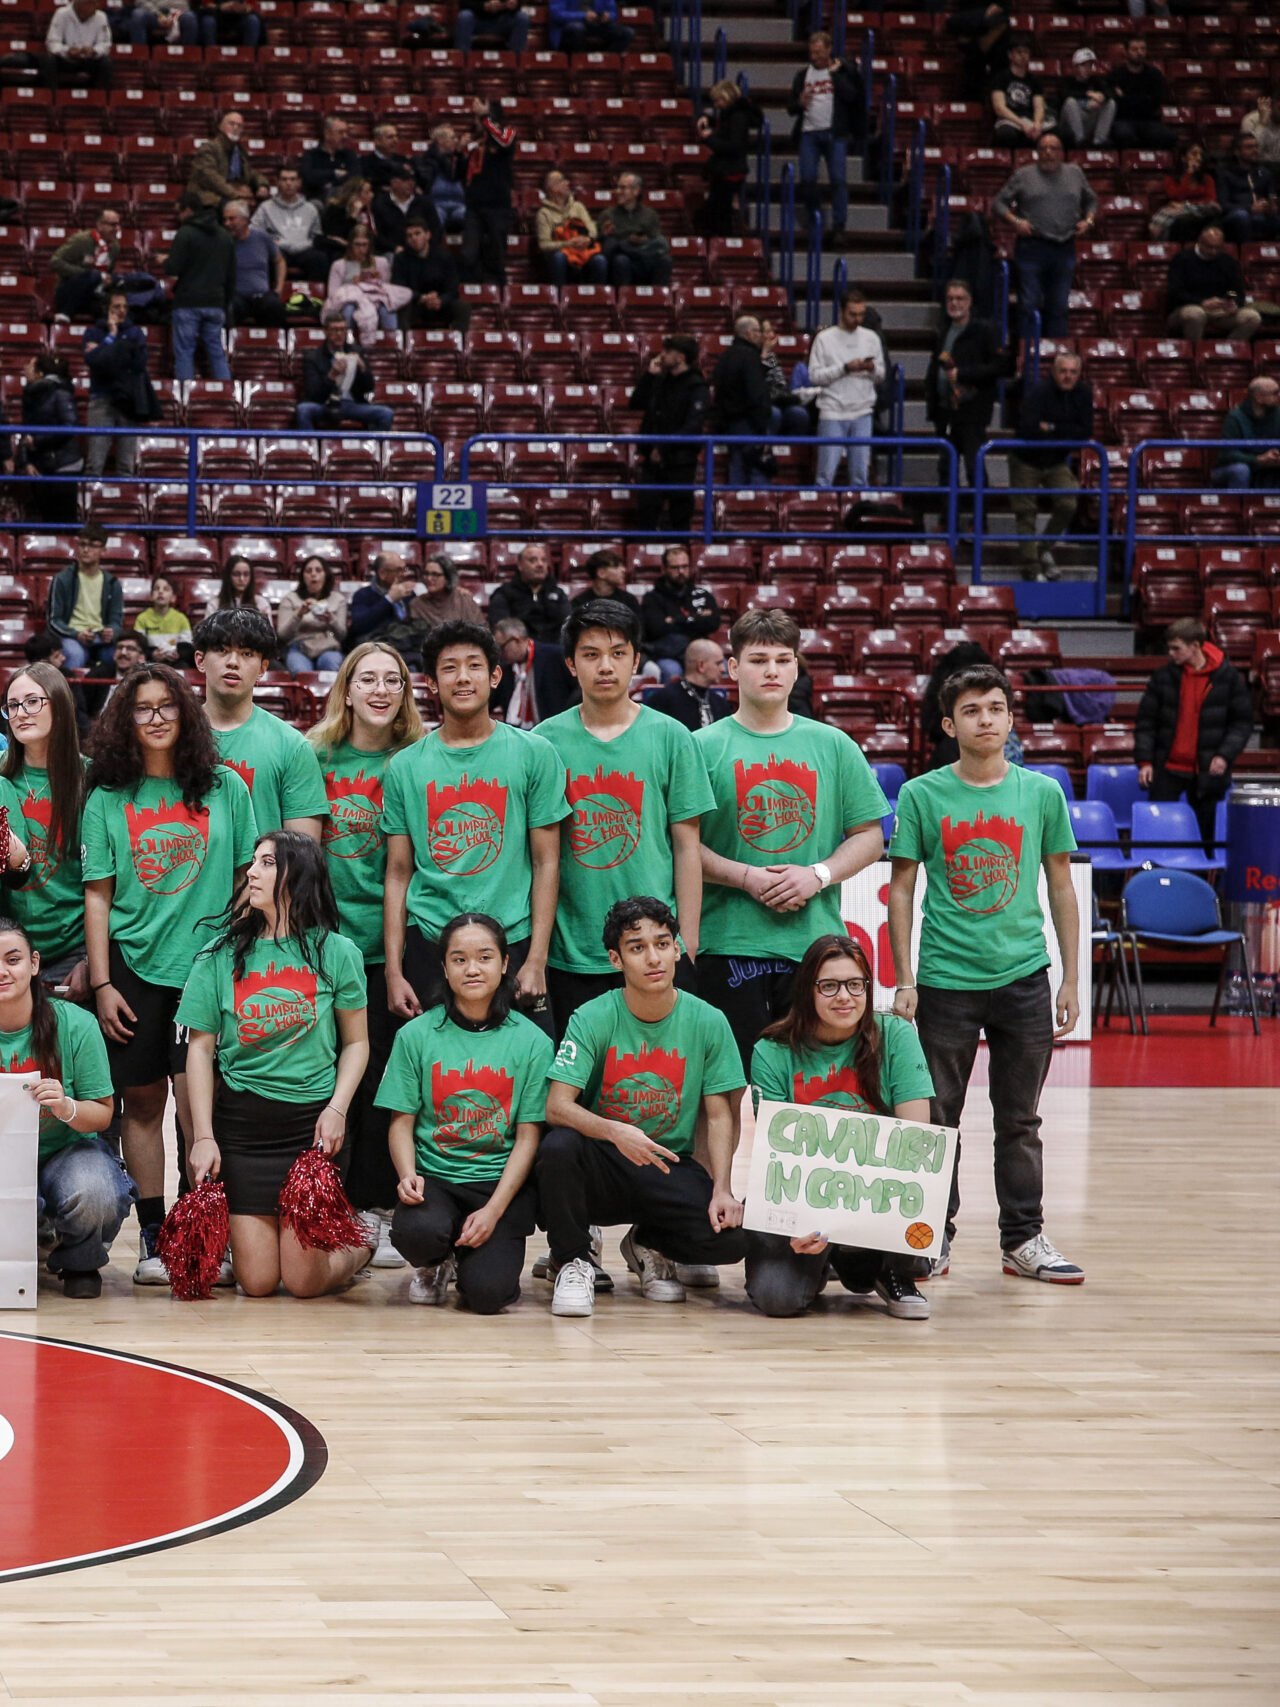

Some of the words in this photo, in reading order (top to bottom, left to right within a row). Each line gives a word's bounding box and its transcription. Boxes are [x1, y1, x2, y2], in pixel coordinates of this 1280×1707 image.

[439, 488, 466, 506] 22
[1246, 866, 1280, 891] Re
[805, 1167, 924, 1219] CAMPO
